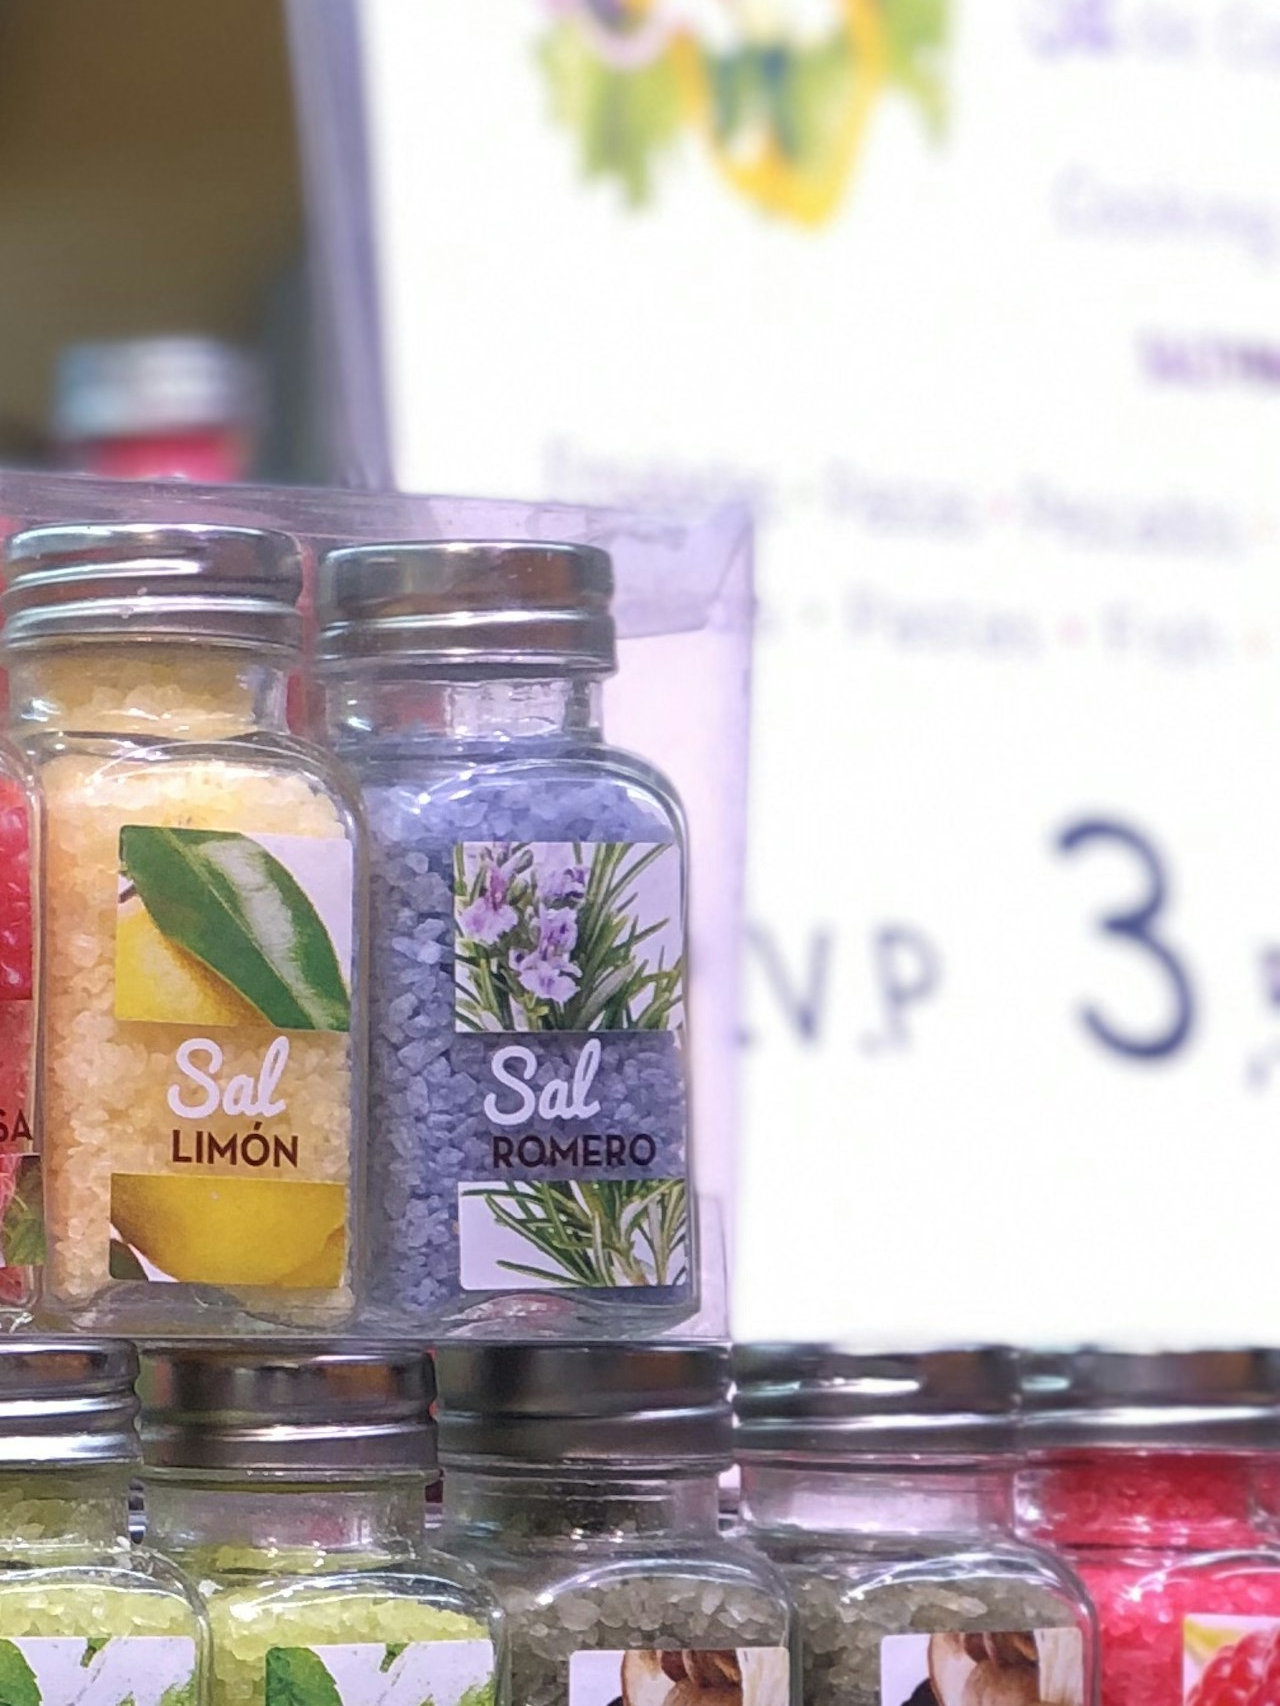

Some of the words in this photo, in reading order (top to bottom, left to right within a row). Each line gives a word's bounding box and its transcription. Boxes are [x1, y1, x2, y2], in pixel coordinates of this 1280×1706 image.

[168, 1036, 289, 1120] Sal
[483, 1046, 601, 1125] Sal
[171, 1122, 298, 1168] LIMÓN
[491, 1133, 656, 1168] ROMERO
